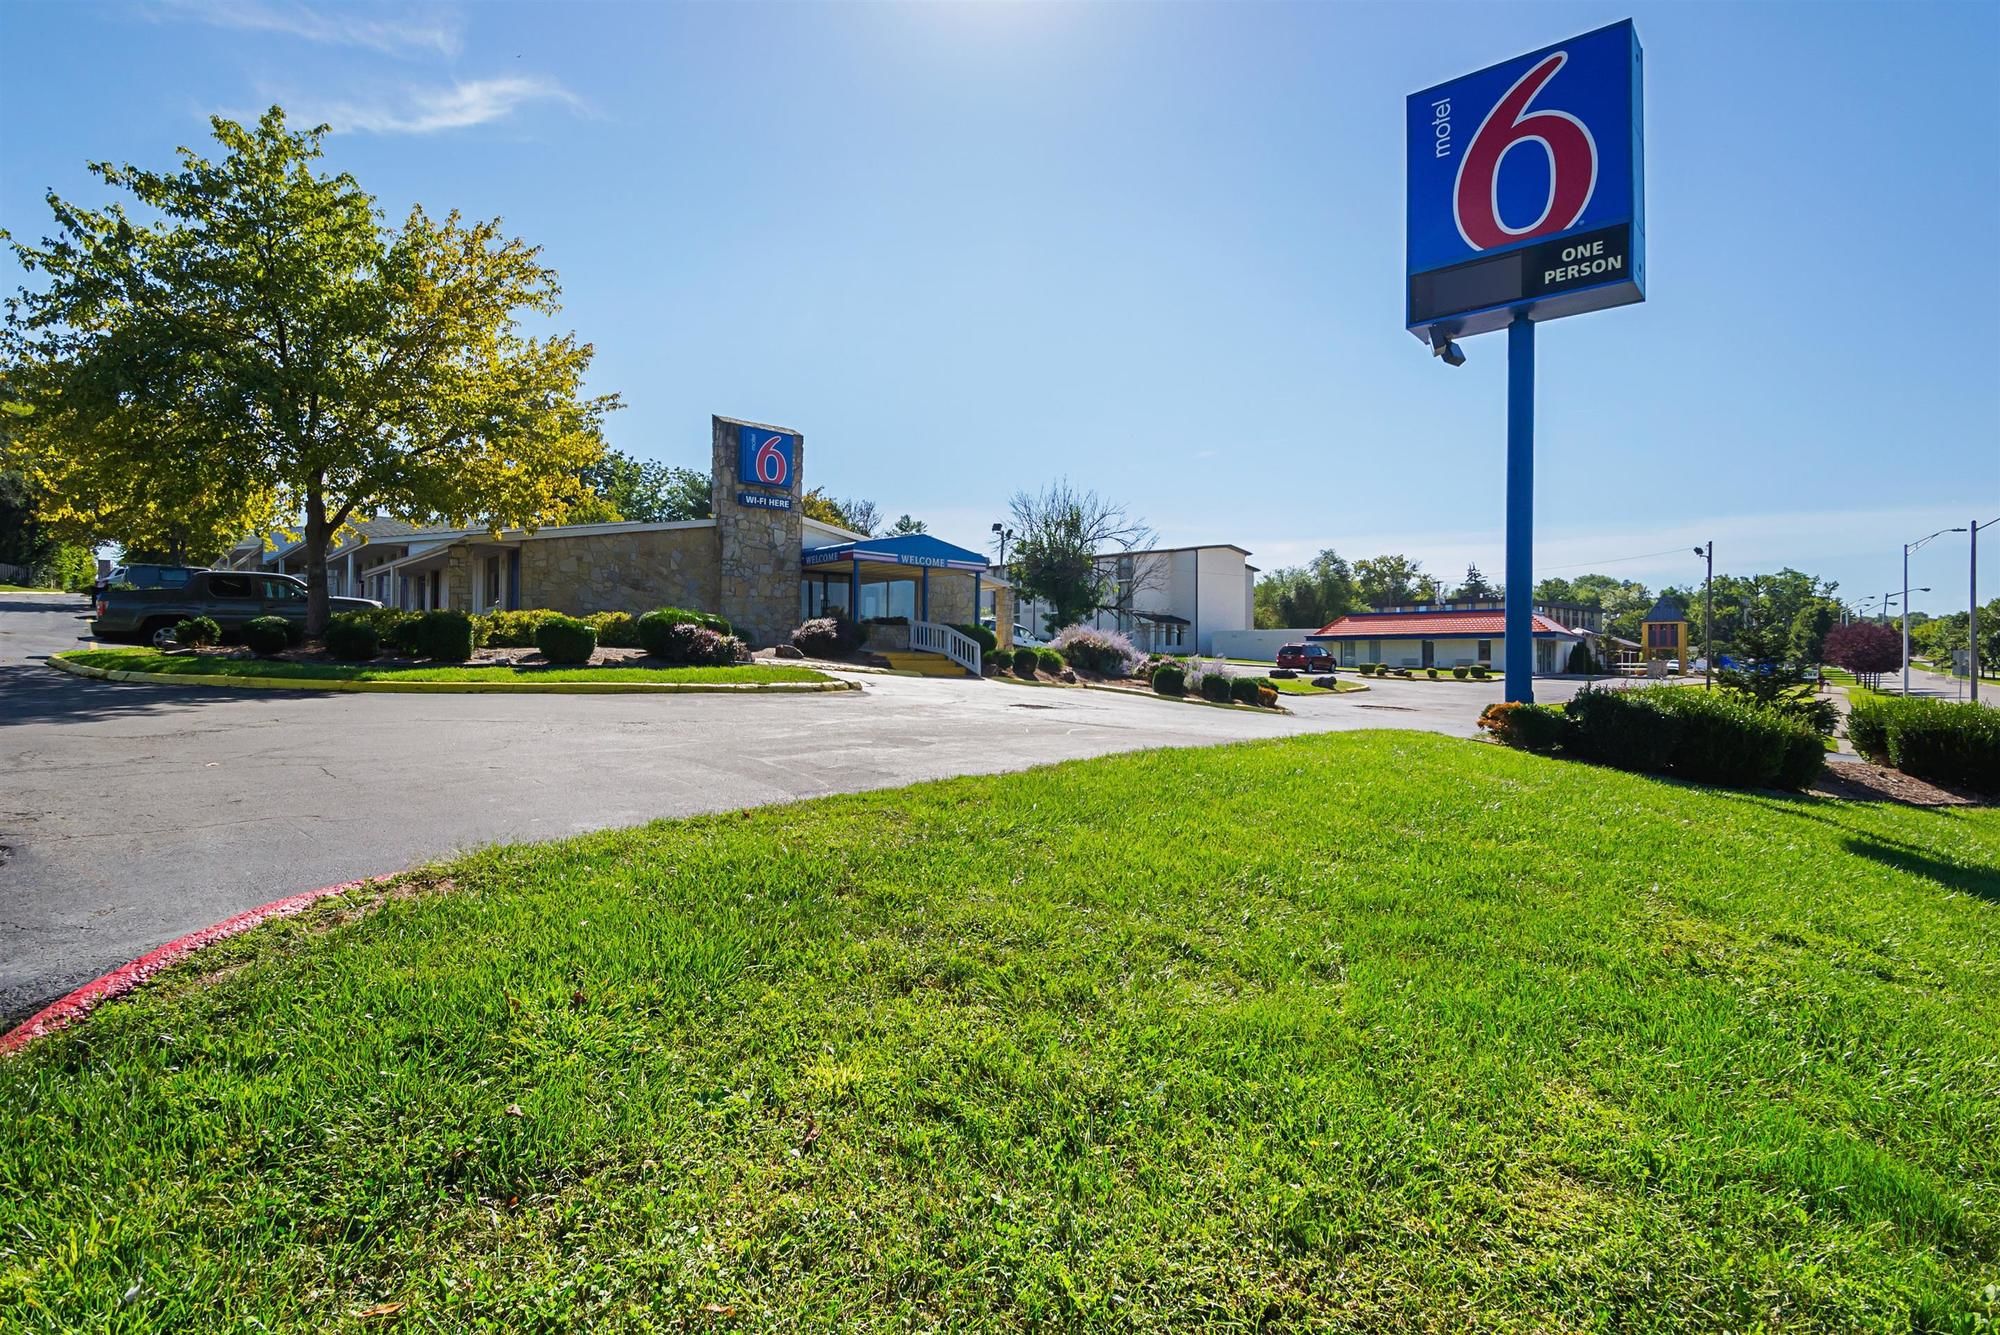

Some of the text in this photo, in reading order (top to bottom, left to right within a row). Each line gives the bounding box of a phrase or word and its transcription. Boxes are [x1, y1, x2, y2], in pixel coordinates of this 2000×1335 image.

[1432, 97, 1451, 159] motel
[1453, 50, 1599, 252] 6
[1562, 240, 1604, 262] ONE
[1544, 255, 1623, 284] PERSON
[756, 435, 787, 485] 6
[745, 495, 790, 508] WI-FI HERE
[805, 552, 839, 565] WELCOME
[901, 554, 945, 568] WELCOME
